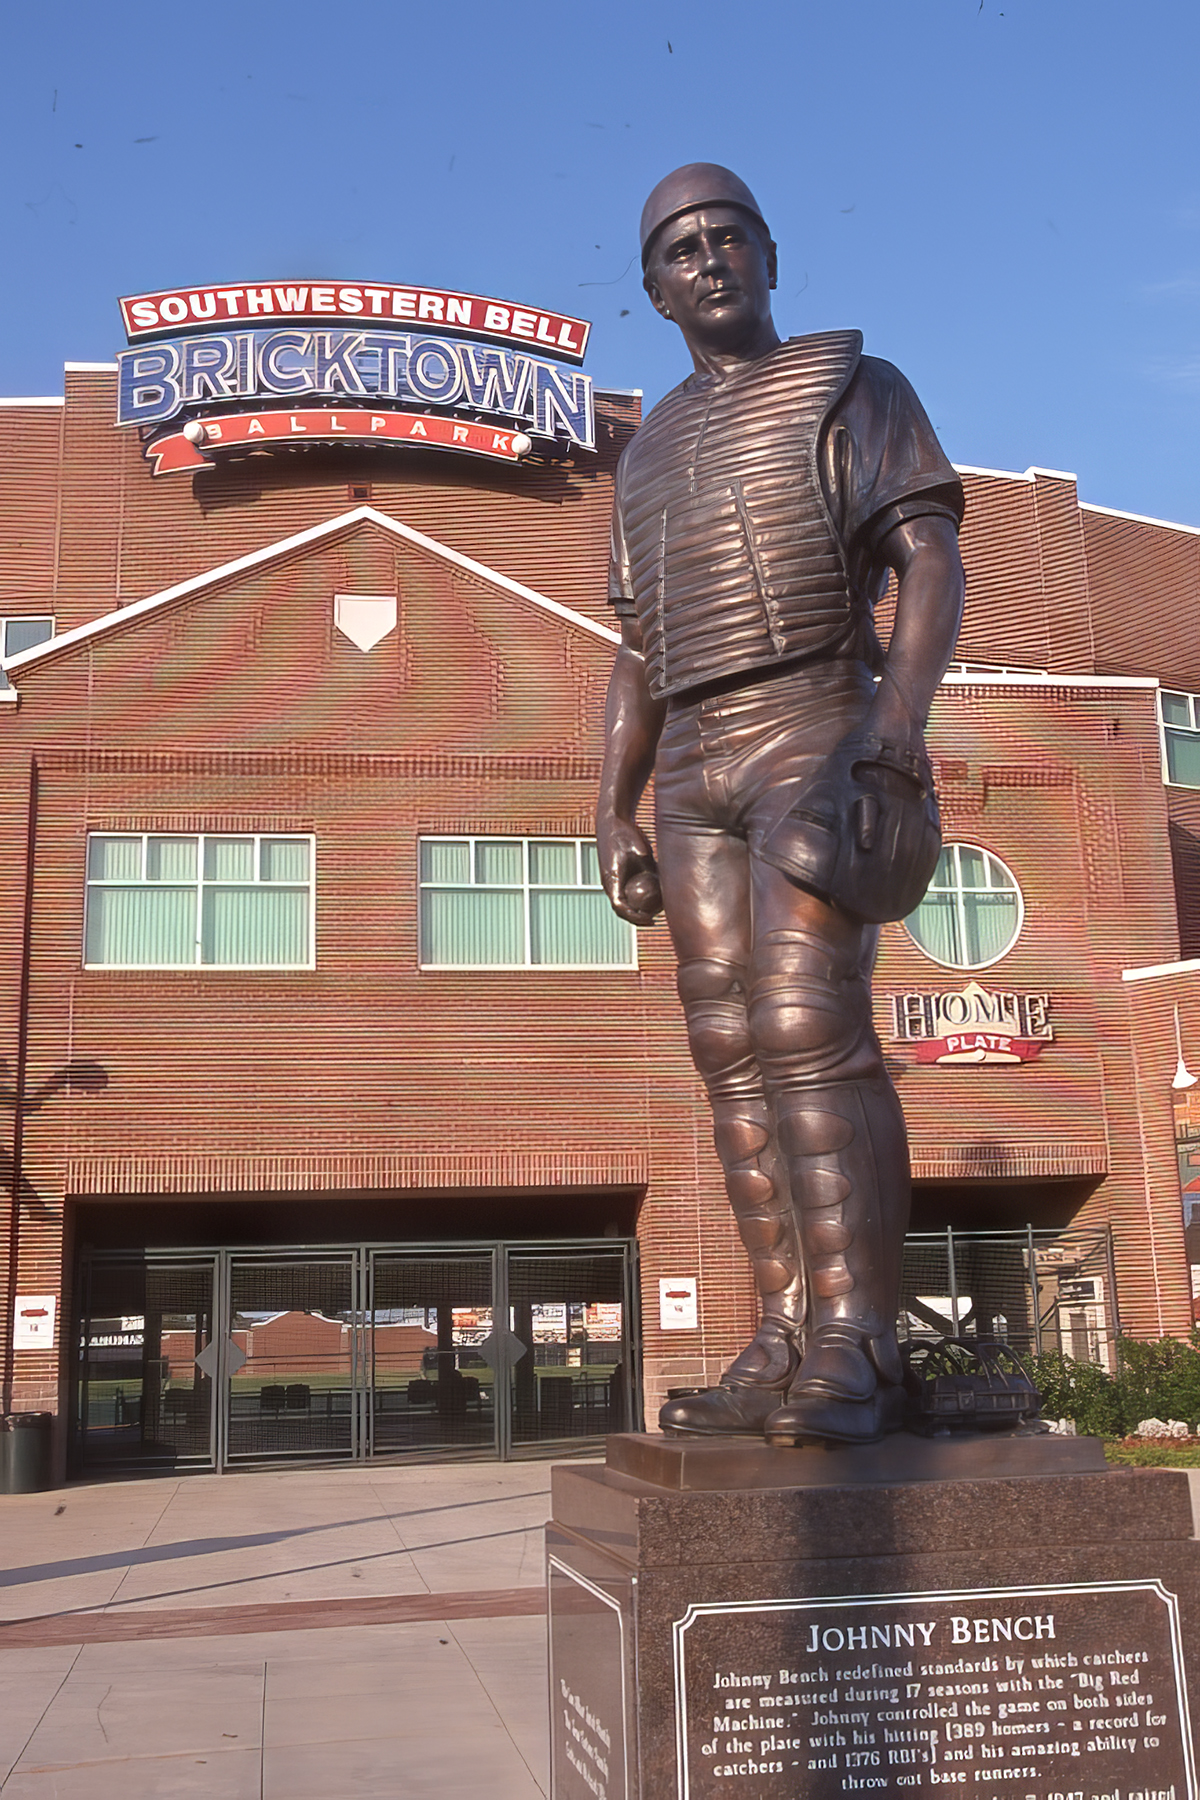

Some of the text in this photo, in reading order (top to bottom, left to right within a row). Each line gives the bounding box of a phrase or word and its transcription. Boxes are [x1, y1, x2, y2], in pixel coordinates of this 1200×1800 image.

[130, 287, 578, 350] SOUTHWESTERN BELL
[114, 331, 597, 453] BRICKTOWN
[203, 416, 509, 452] BALLPARK
[886, 991, 1053, 1040] HOME
[946, 1036, 1012, 1051] PLATE
[806, 1615, 1056, 1652] JOHNNY BENCH
[713, 1650, 1148, 1690] Johnny Bench redefined standards by which catchers
[725, 1696, 751, 1709] are
[759, 1688, 838, 1708] measured
[845, 1687, 899, 1703] during
[906, 1683, 922, 1698] 17
[928, 1682, 989, 1697] seasons
[996, 1676, 1032, 1692] with
[1038, 1675, 1063, 1690] the
[1110, 1669, 1139, 1685] Red
[811, 1711, 869, 1726] Johnny
[877, 1703, 958, 1722] controlled
[966, 1701, 991, 1716] the
[998, 1699, 1040, 1719] game
[1046, 1700, 1067, 1711] on
[1074, 1693, 1109, 1709] both
[1115, 1691, 1153, 1707] sides
[701, 1738, 718, 1755] of
[726, 1738, 753, 1753] the
[760, 1735, 801, 1755] plate
[809, 1731, 846, 1748] with
[853, 1730, 875, 1745] his
[884, 1728, 939, 1746] hitting
[992, 1720, 1050, 1736] homers
[1073, 1720, 1082, 1731] a
[1089, 1712, 1139, 1730] record
[1146, 1710, 1167, 1727] for
[713, 1759, 783, 1777] catchers
[808, 1754, 838, 1770] and
[845, 1751, 880, 1767] 1376
[944, 1745, 973, 1761] and
[981, 1744, 1004, 1758] his
[1011, 1740, 1080, 1757] amazing
[1087, 1735, 1137, 1753] ability
[1143, 1735, 1160, 1748] to
[842, 1767, 1042, 1790] throw out base runners.
